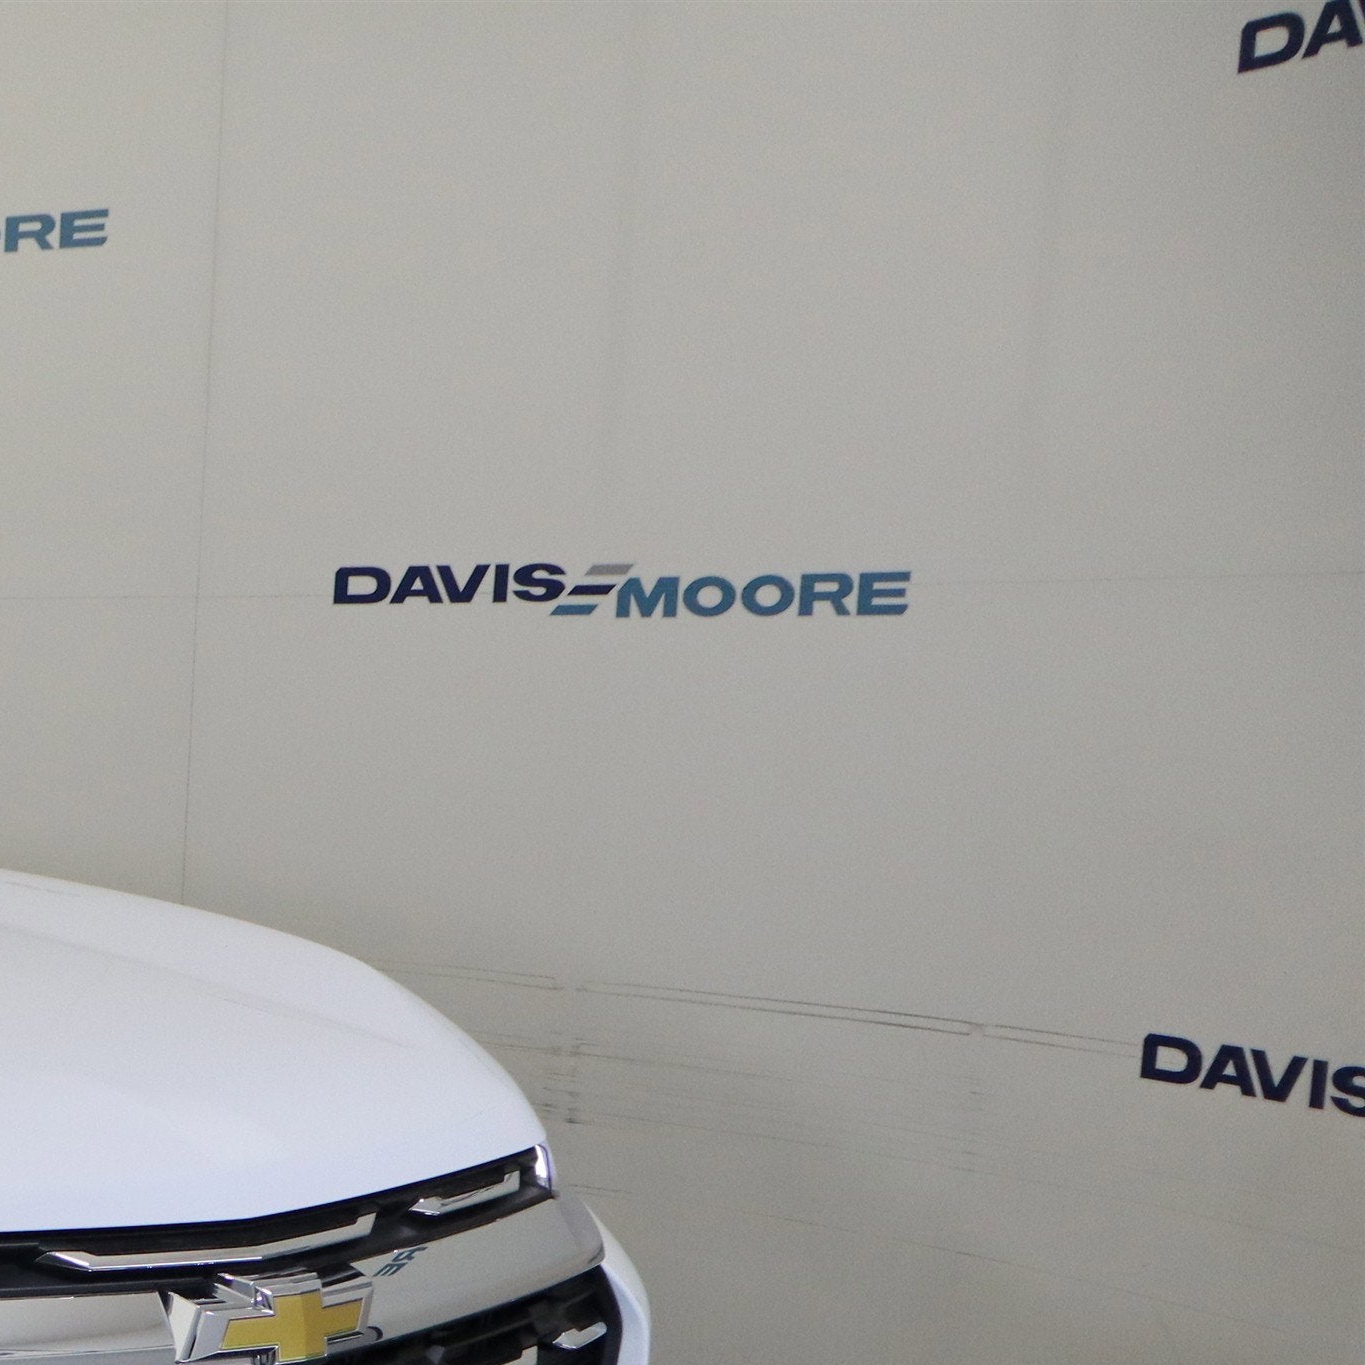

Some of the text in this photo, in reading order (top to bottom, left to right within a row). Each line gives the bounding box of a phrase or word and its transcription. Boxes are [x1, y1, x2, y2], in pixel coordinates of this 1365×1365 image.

[1237, 0, 1365, 74] DA
[333, 562, 912, 619] DAVIS MOORE
